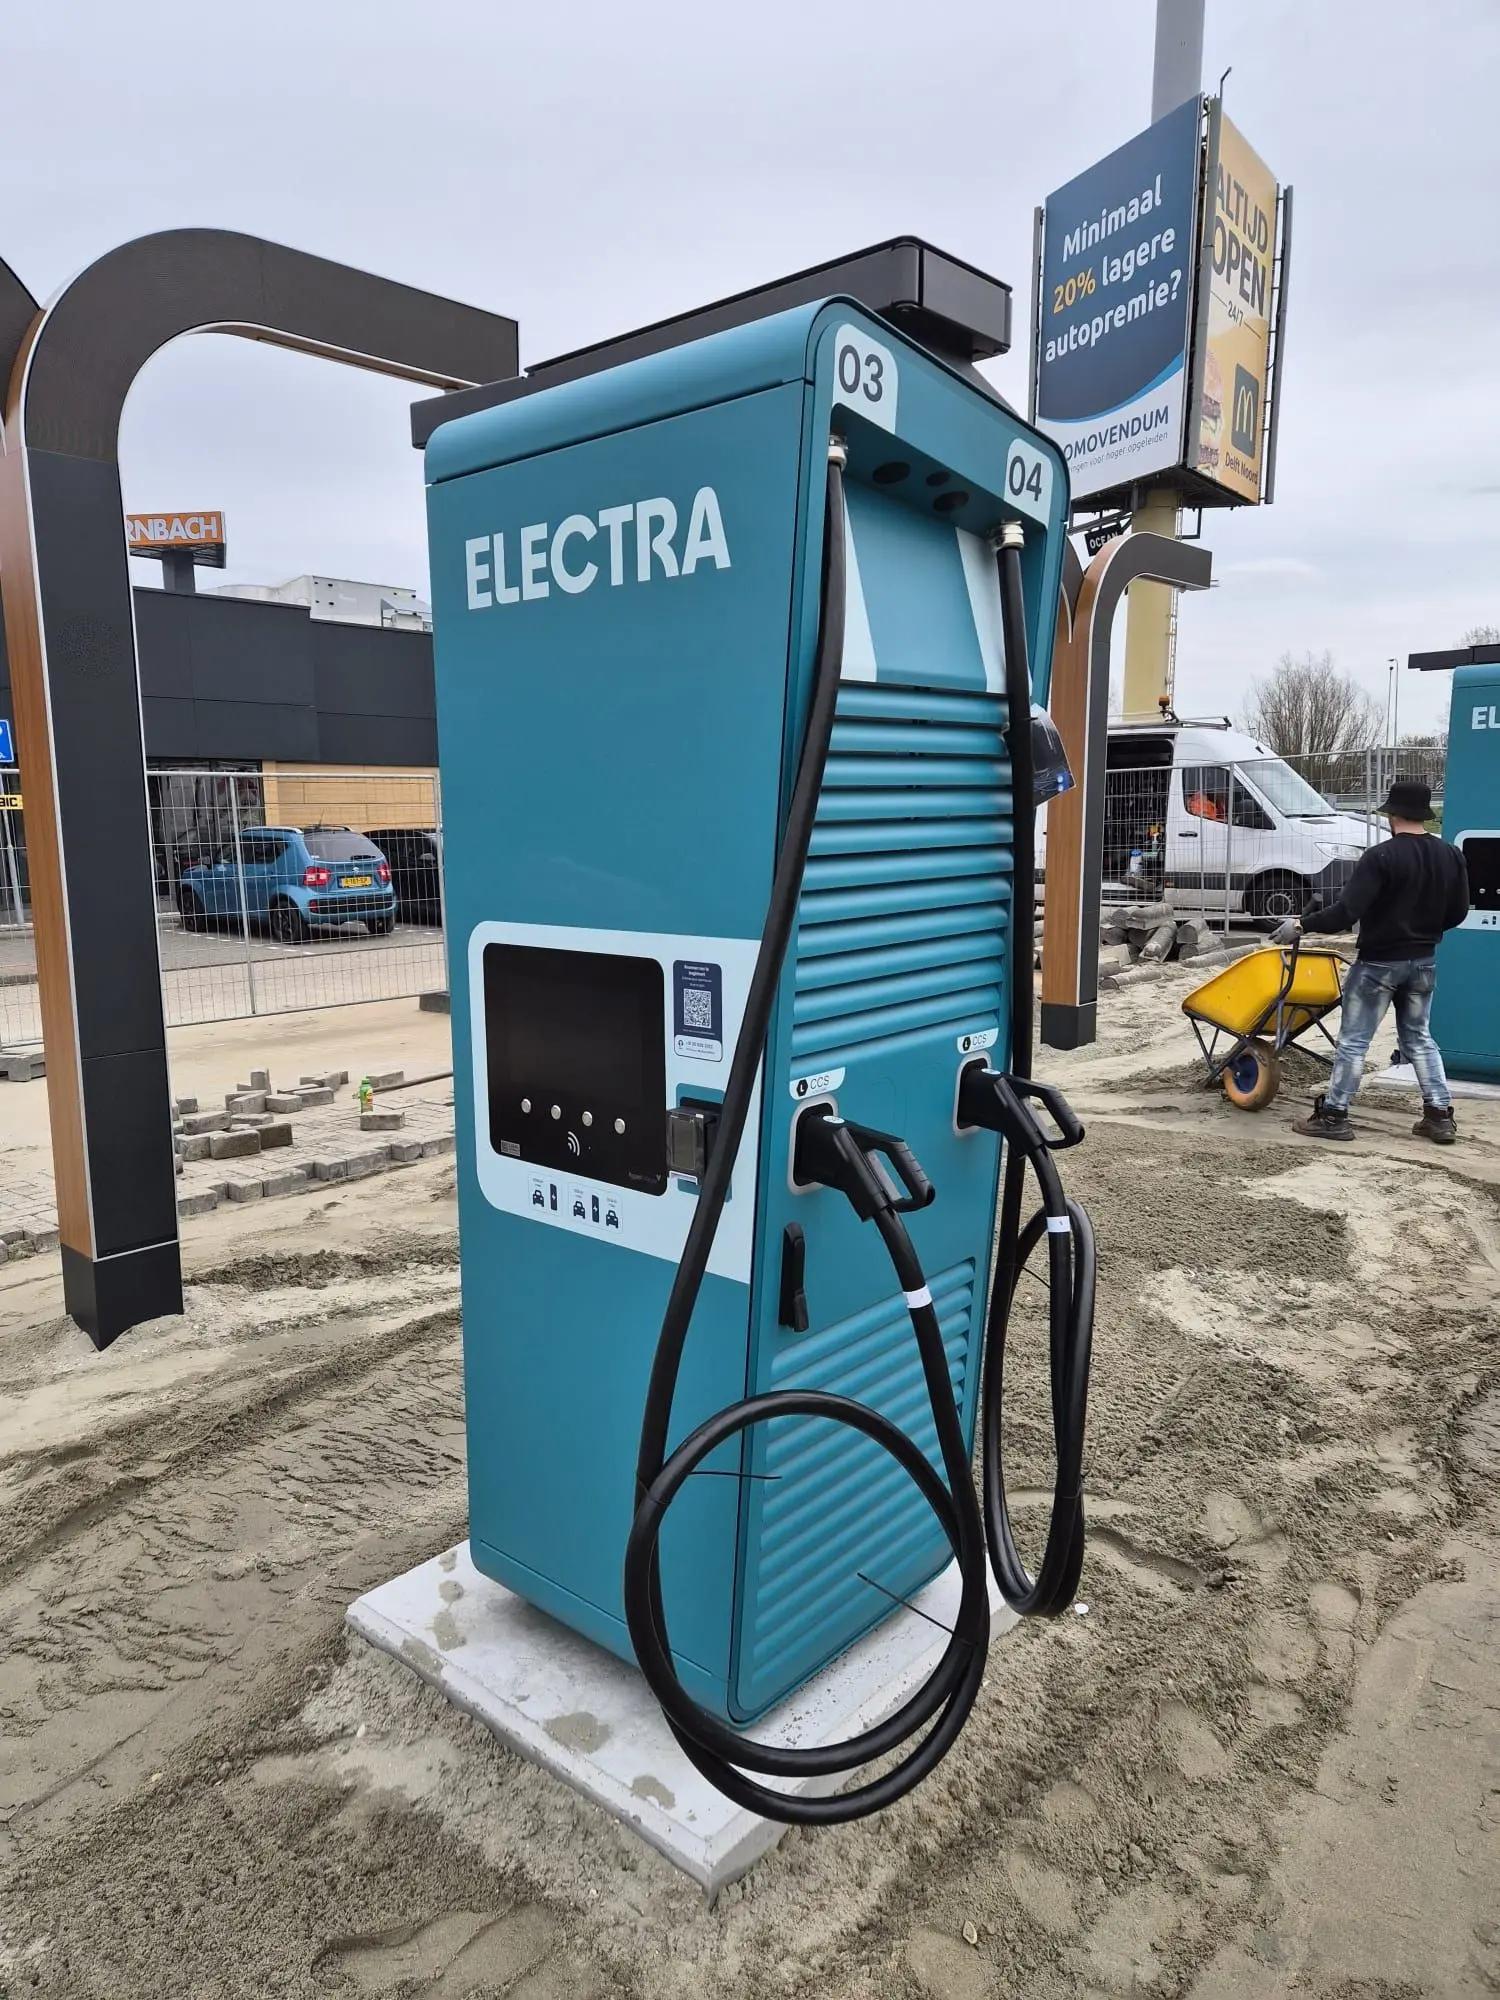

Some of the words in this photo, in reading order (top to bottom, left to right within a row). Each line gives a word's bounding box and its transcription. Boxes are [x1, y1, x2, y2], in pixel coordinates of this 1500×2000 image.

[1062, 173, 1162, 263] Minimaal
[1216, 162, 1268, 254] ALTIJD
[1053, 267, 1096, 314] 20%
[1102, 228, 1176, 286] lagere
[1213, 215, 1266, 317] OPEN
[1045, 268, 1182, 363] autopremie?
[1227, 300, 1244, 327] 24/7
[838, 344, 884, 402] 03
[1008, 455, 1043, 503] 04
[1225, 451, 1240, 474] Delft
[1241, 461, 1258, 485] Noord
[465, 486, 732, 611] ELECTRA
[972, 1034, 987, 1046] CCS
[810, 1075, 829, 1090] CCS
